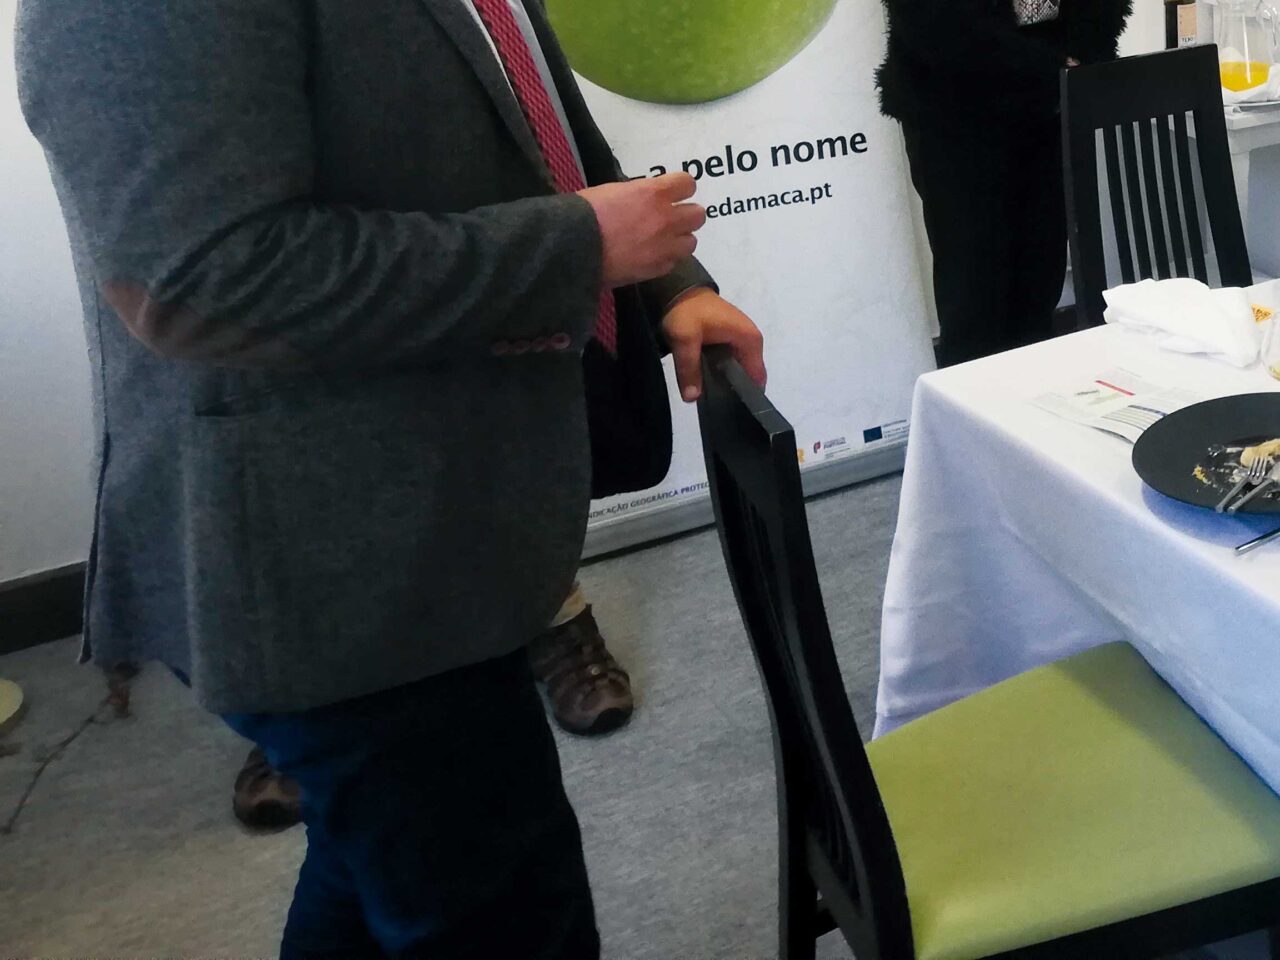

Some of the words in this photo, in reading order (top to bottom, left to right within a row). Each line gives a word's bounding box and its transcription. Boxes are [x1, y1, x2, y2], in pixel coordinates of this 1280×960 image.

[682, 145, 758, 181] pelo
[771, 132, 868, 167] nome
[706, 182, 833, 219] edamaca.pt
[589, 502, 629, 519] NDICAÇÃO
